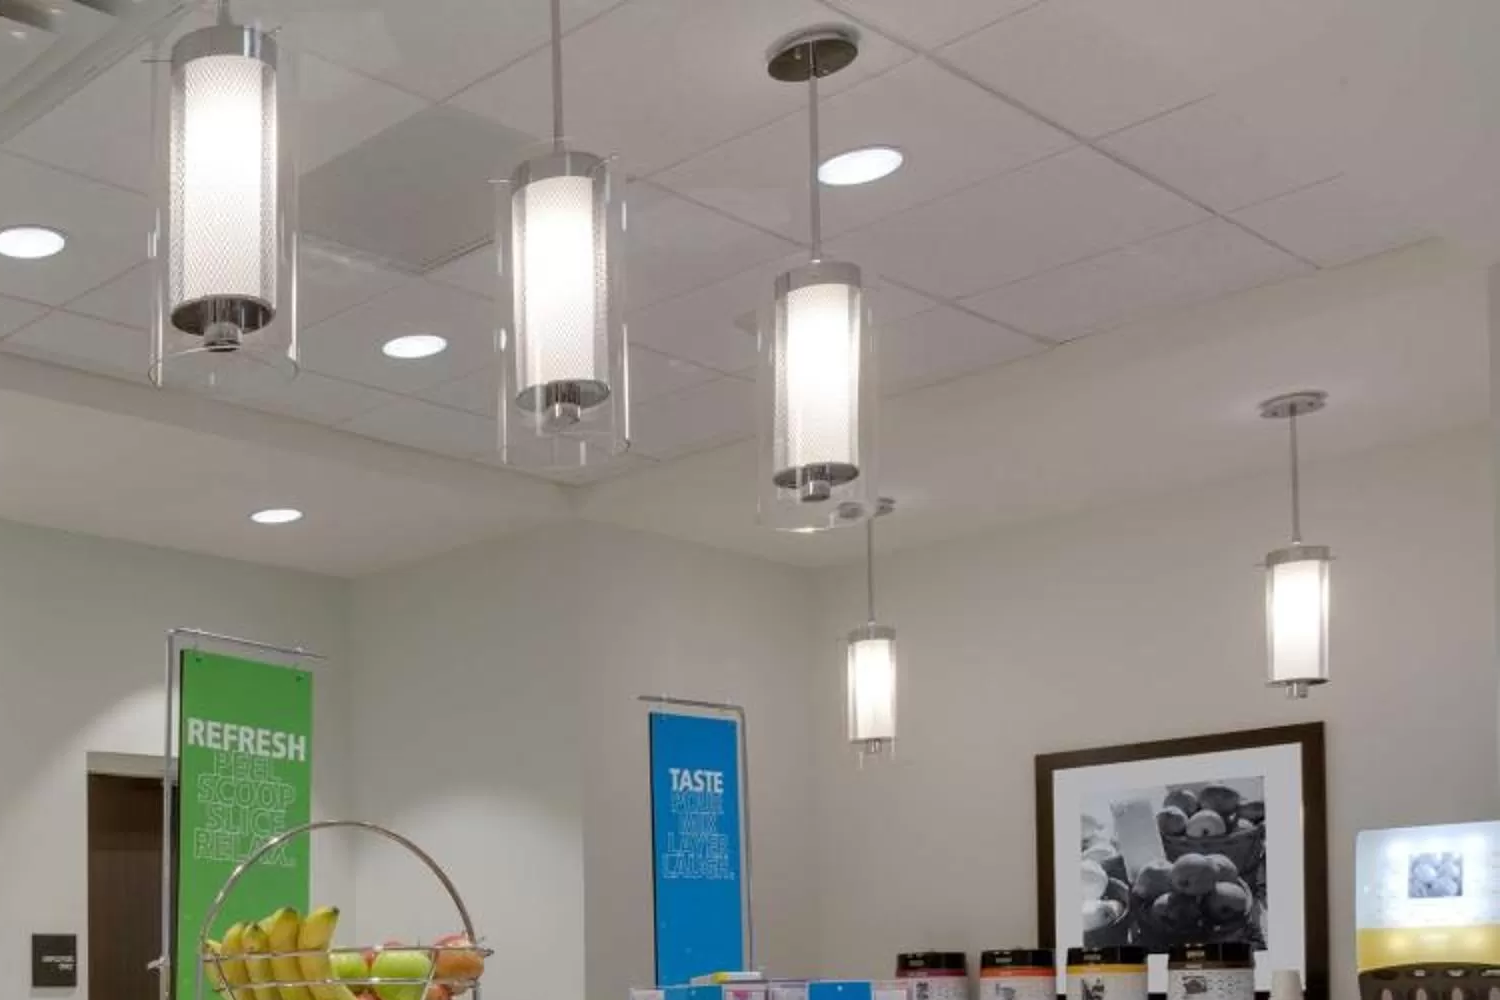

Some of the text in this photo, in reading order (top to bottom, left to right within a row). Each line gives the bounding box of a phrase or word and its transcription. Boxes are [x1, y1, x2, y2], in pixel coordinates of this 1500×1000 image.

[187, 717, 307, 762] REFRESH
[197, 773, 296, 811] SCOOP
[668, 767, 724, 794] TASTE
[205, 802, 287, 837] SLICE
